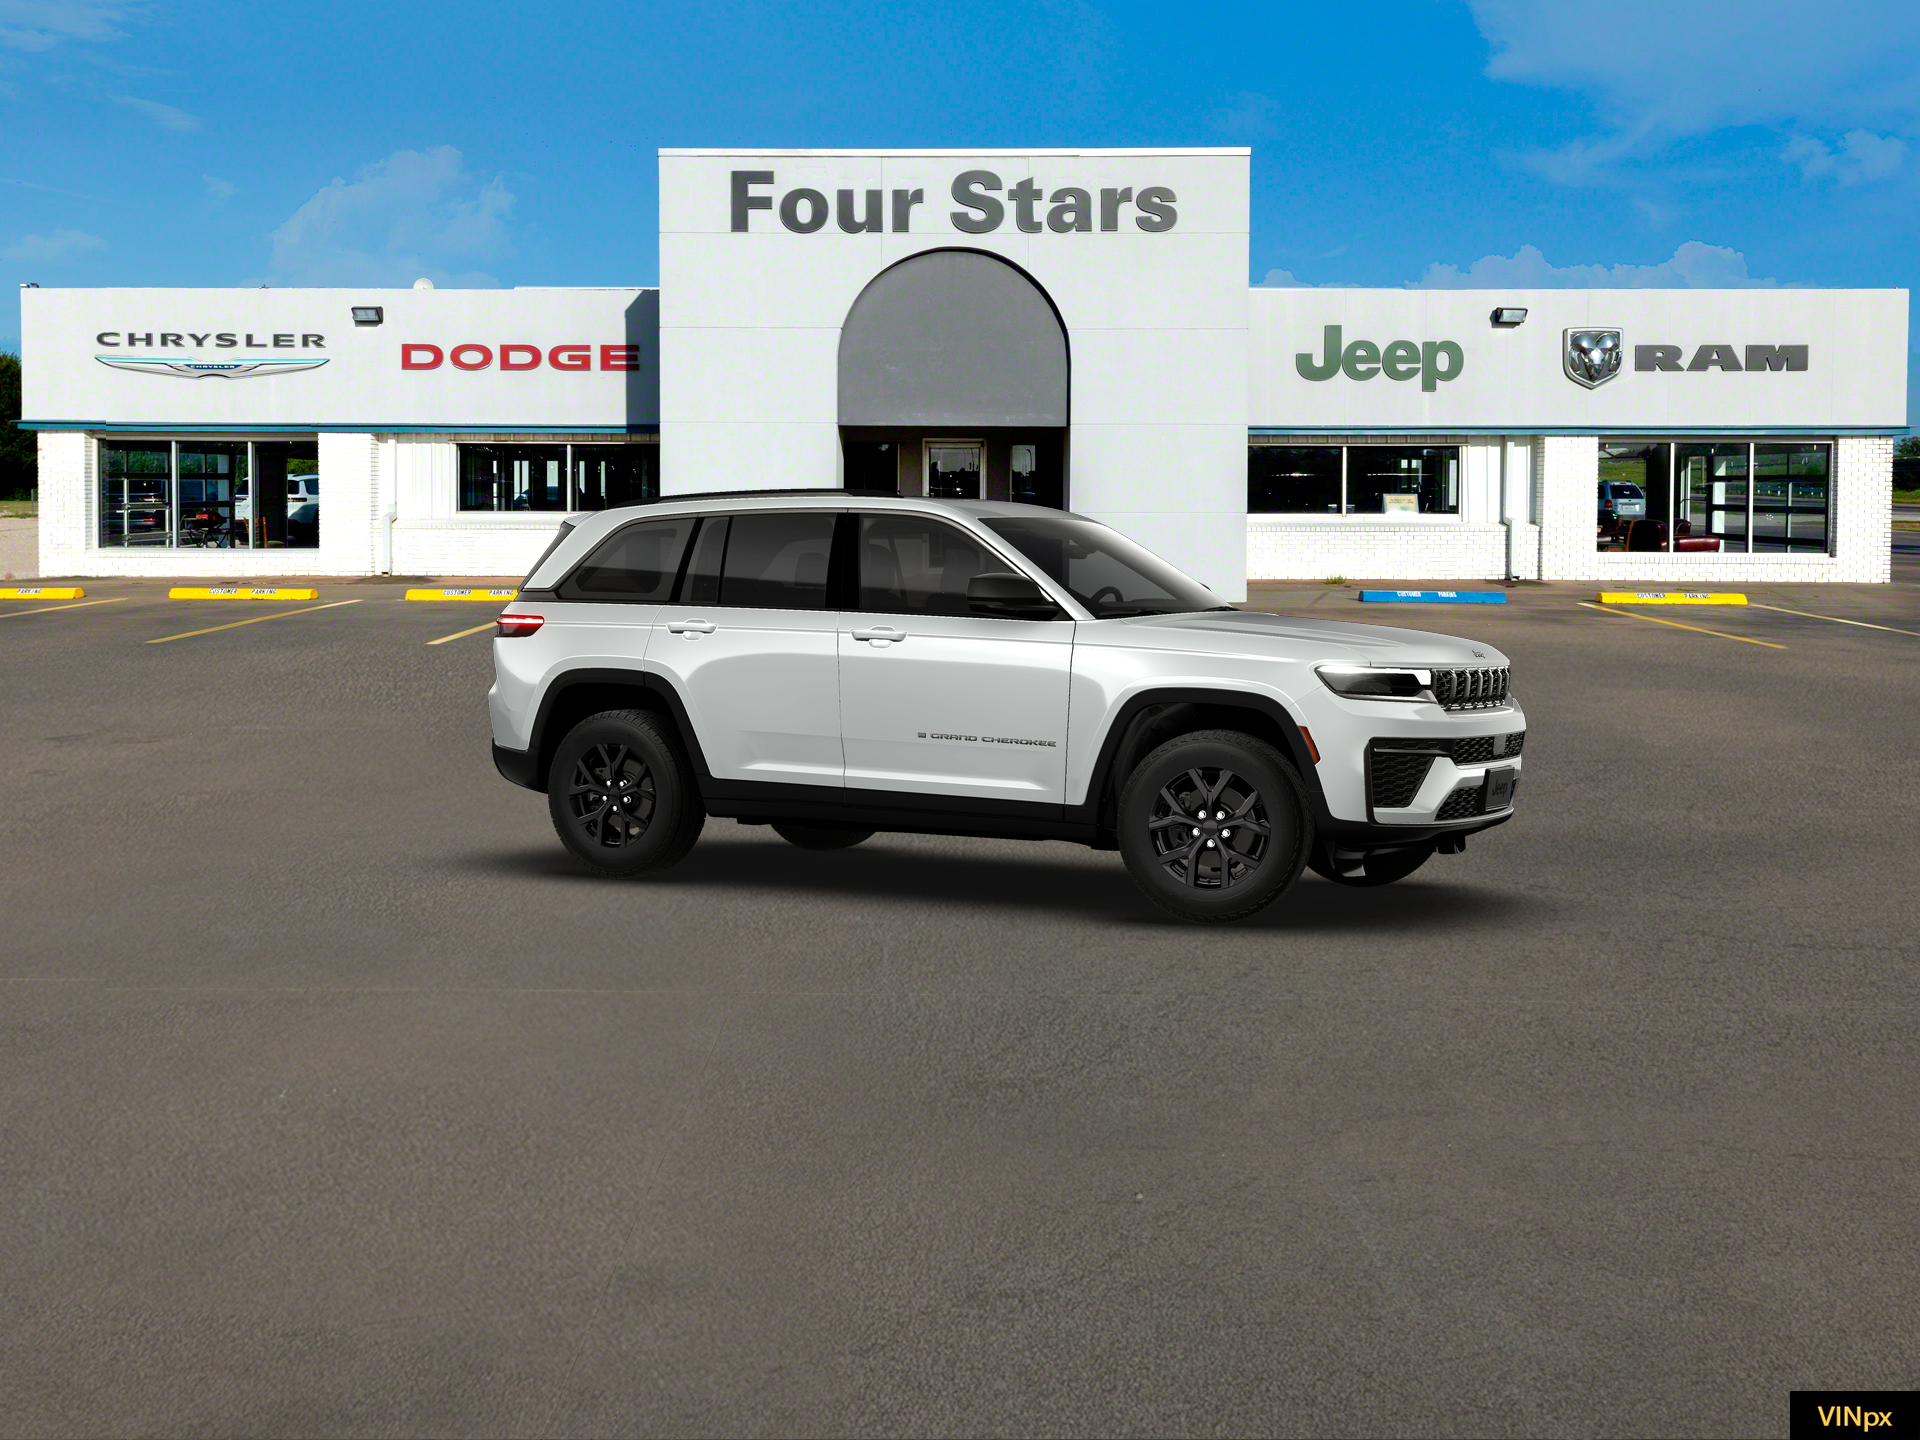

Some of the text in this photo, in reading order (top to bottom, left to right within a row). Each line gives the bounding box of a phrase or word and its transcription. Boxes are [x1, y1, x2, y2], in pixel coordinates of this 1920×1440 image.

[730, 169, 1178, 234] Four Stars
[96, 332, 327, 349] CHRYSLER
[401, 343, 640, 372] DODGE
[1295, 324, 1464, 392] Jeep
[1635, 344, 1809, 372] RAM
[930, 732, 1057, 748] GRAND CHEROKEE
[1491, 778, 1508, 798] Jeep
